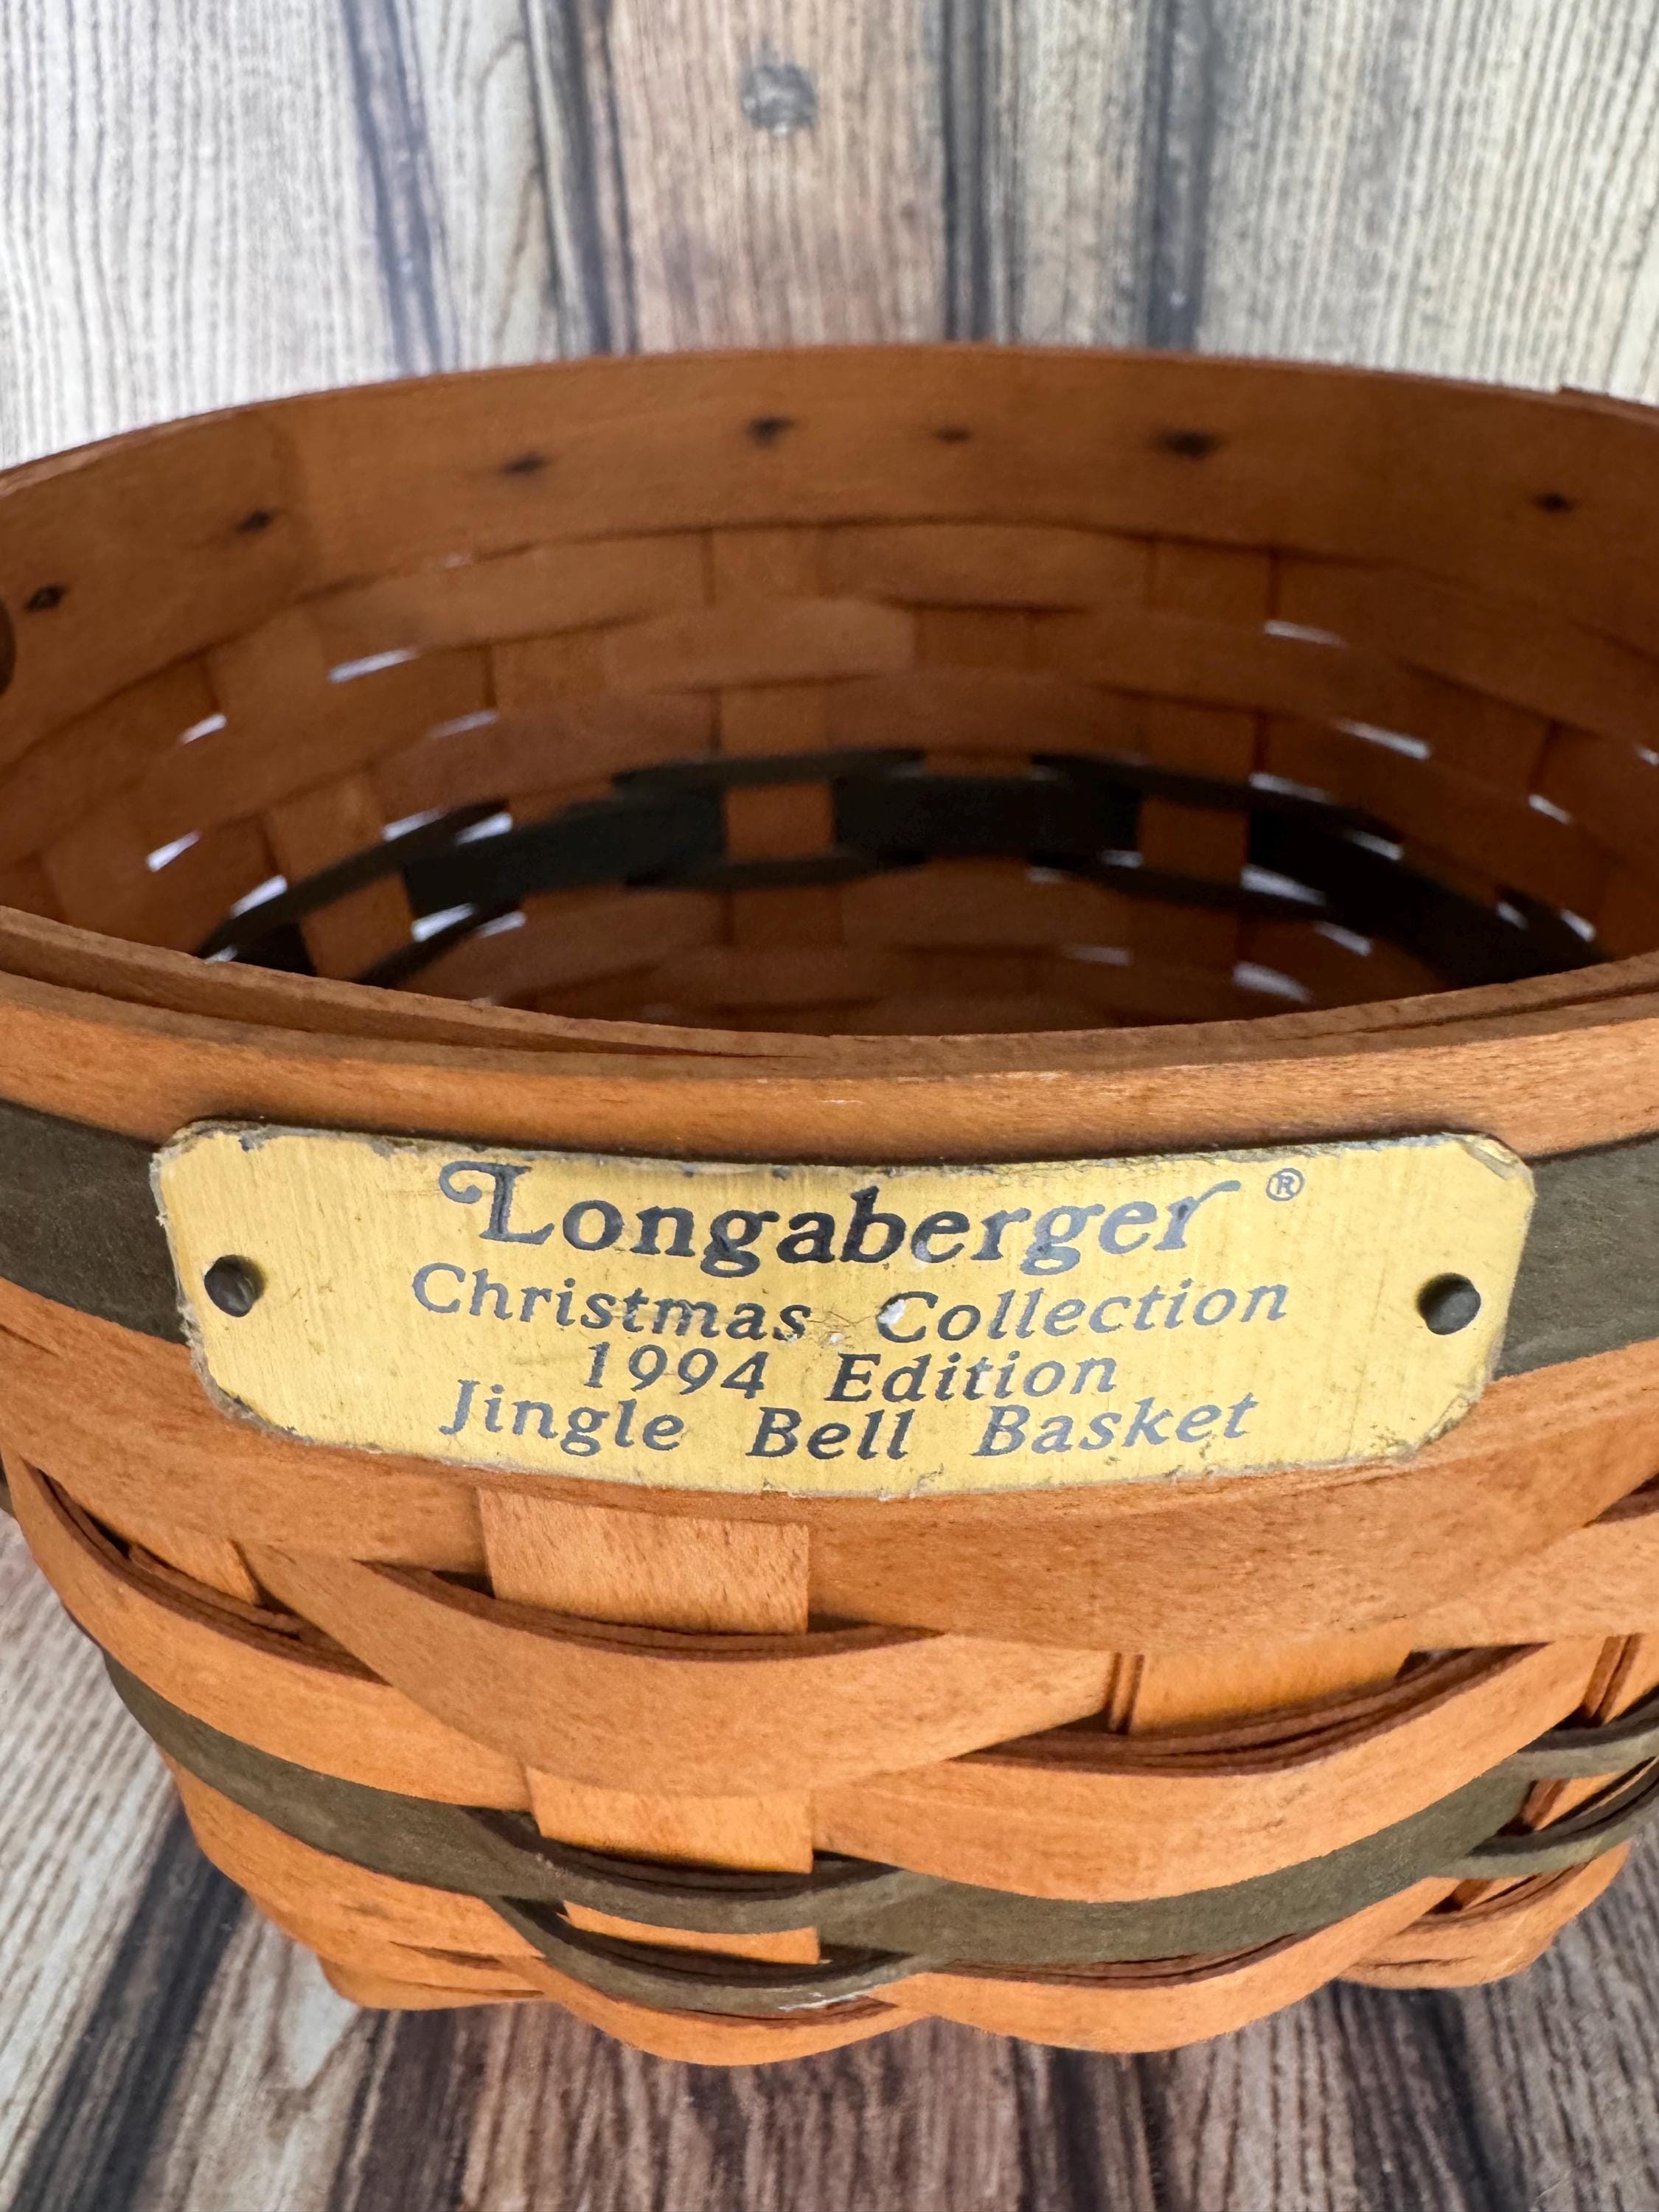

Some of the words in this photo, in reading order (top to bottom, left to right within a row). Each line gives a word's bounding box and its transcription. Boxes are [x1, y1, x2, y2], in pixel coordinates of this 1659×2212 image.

[439, 1160, 1242, 1279] Longaberger
[411, 1262, 812, 1341] Christmas
[875, 1279, 1292, 1343] Collection
[584, 1341, 769, 1399] 1994
[824, 1350, 1117, 1402] Edition
[439, 1379, 685, 1457] Jingle
[745, 1406, 916, 1461] Bell
[970, 1393, 1259, 1457] Basket
